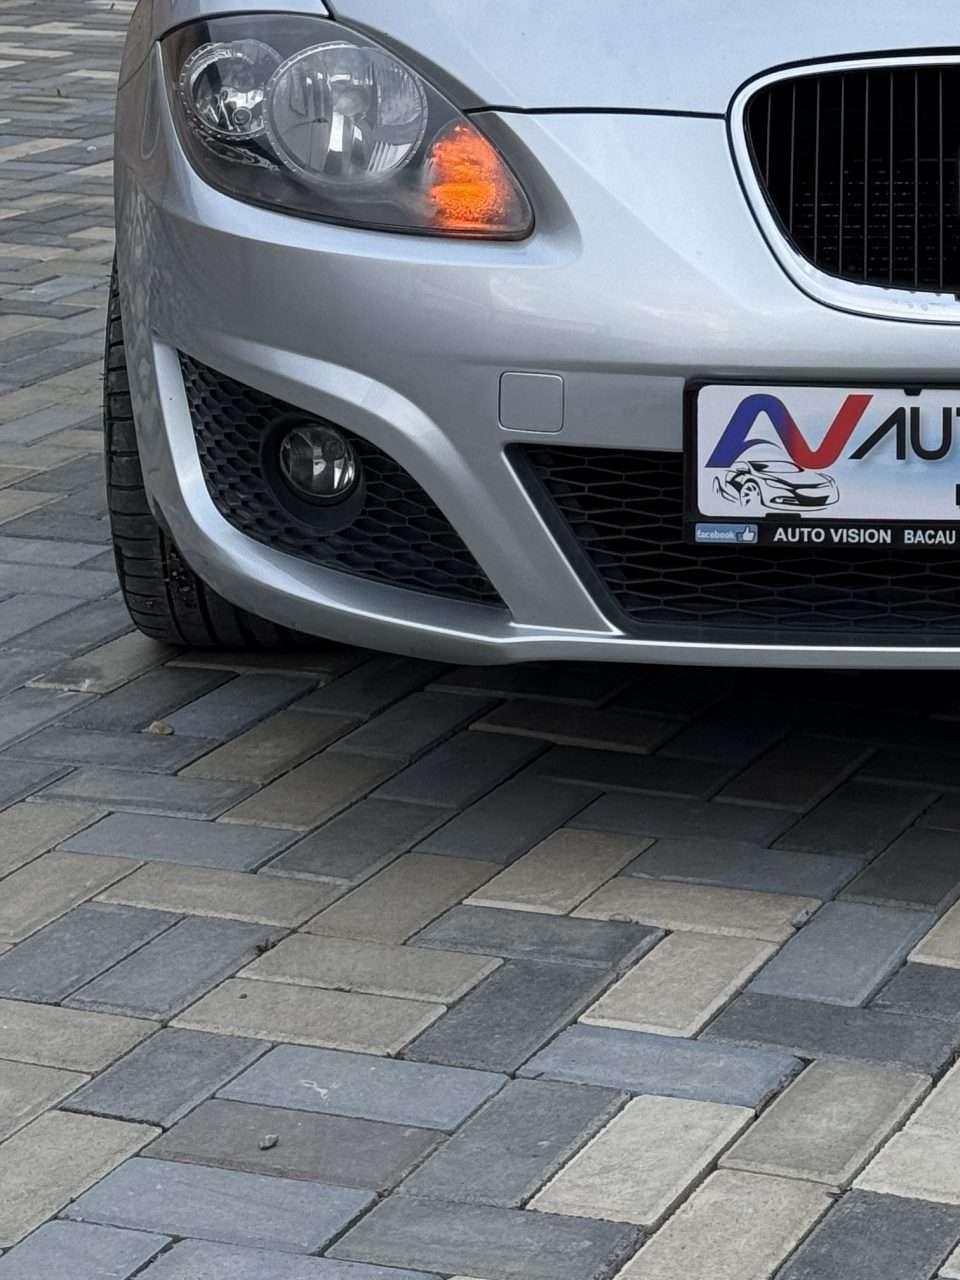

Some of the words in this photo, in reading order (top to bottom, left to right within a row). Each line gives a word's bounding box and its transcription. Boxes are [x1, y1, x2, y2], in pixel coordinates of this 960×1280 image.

[773, 527, 826, 543] AUTO
[830, 528, 892, 544] VISION
[903, 529, 956, 545] BACAU
